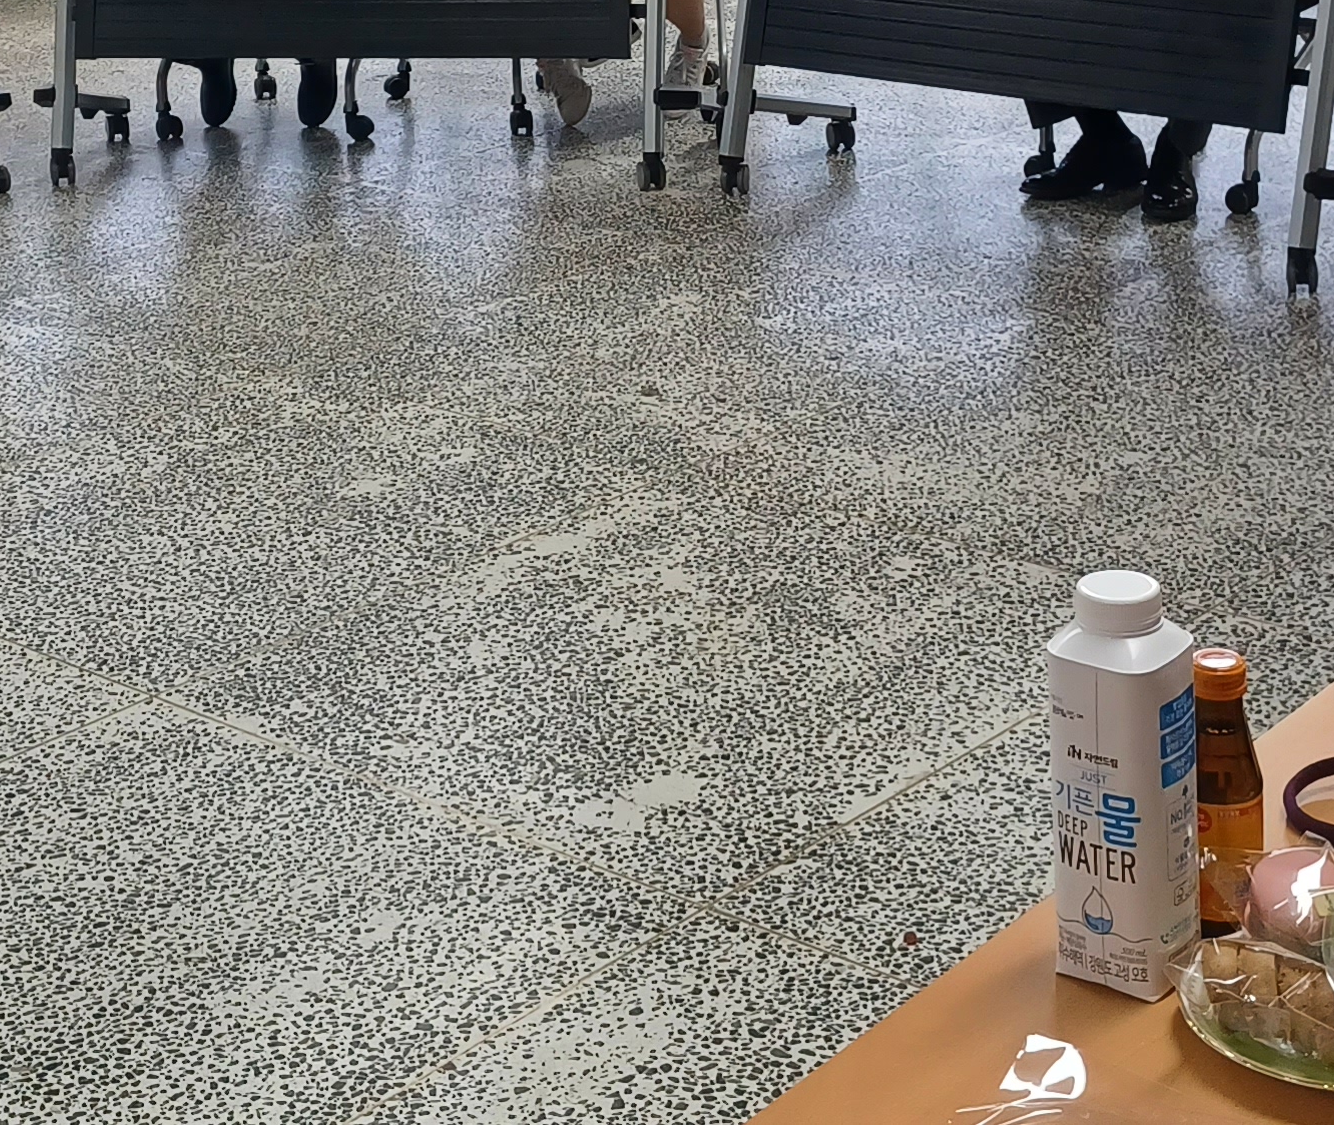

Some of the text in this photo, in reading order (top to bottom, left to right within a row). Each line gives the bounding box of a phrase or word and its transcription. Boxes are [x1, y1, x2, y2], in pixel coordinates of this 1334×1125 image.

[1084, 752, 1118, 769] 자연드림
[1080, 770, 1108, 785] JUST
[1055, 780, 1142, 848] 기픈 물
[1057, 810, 1088, 837] DEEP
[1058, 831, 1136, 885] WATER
[1088, 954, 1113, 976] 강원도
[1114, 963, 1130, 982] 고성
[1131, 967, 1149, 983] 오호
